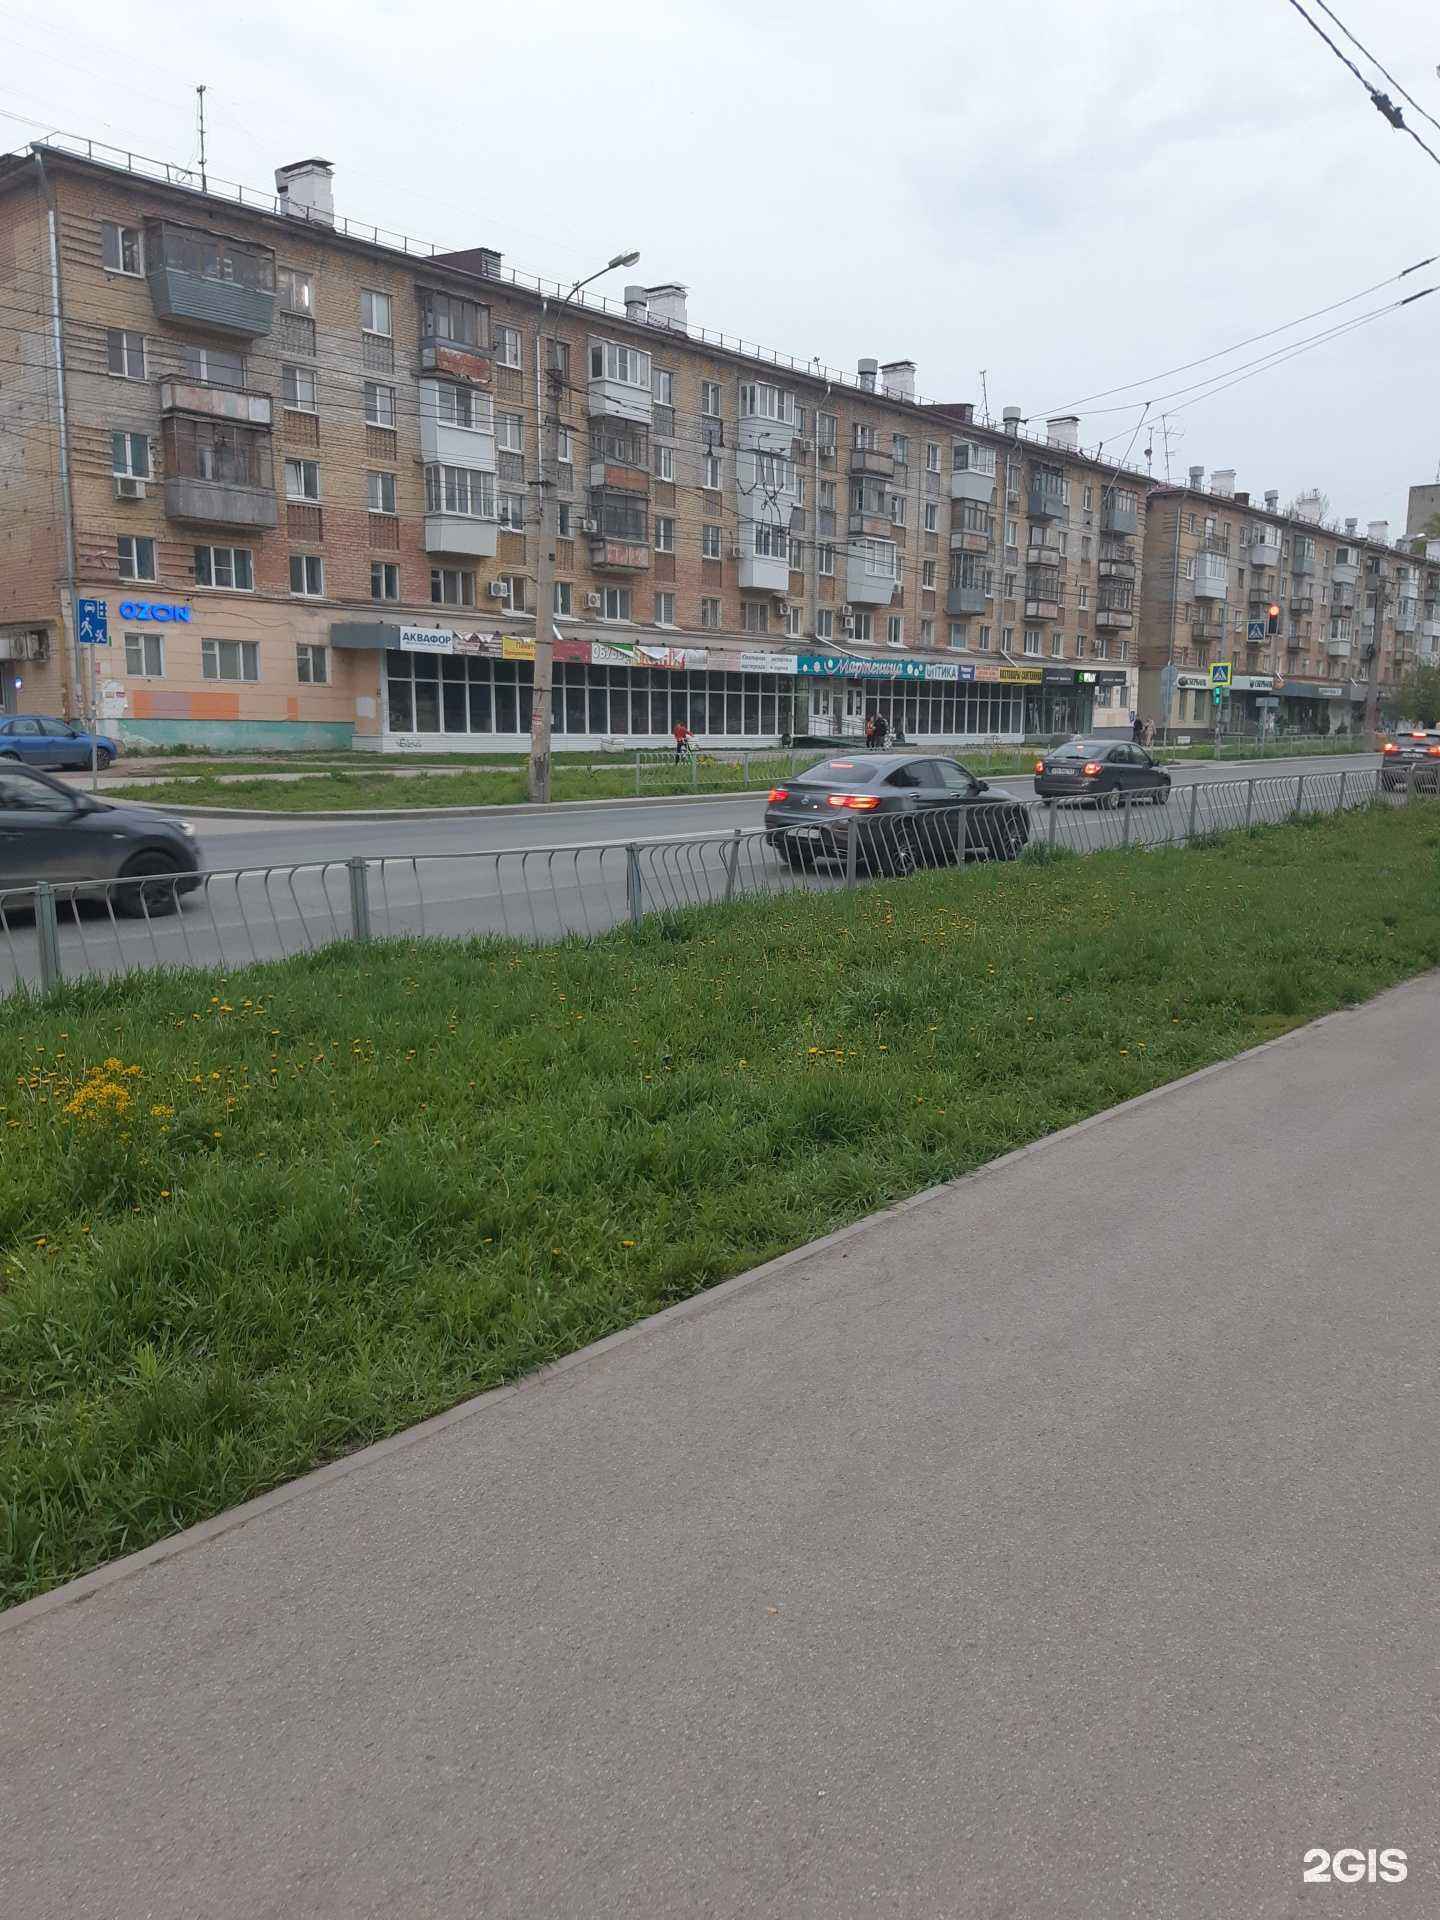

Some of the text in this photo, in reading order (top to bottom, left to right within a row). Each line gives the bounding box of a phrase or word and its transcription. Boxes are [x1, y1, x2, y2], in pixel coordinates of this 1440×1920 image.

[119, 601, 191, 623] OZON
[402, 632, 451, 644] АКВАФОР
[926, 664, 957, 679] ОПТИКА
